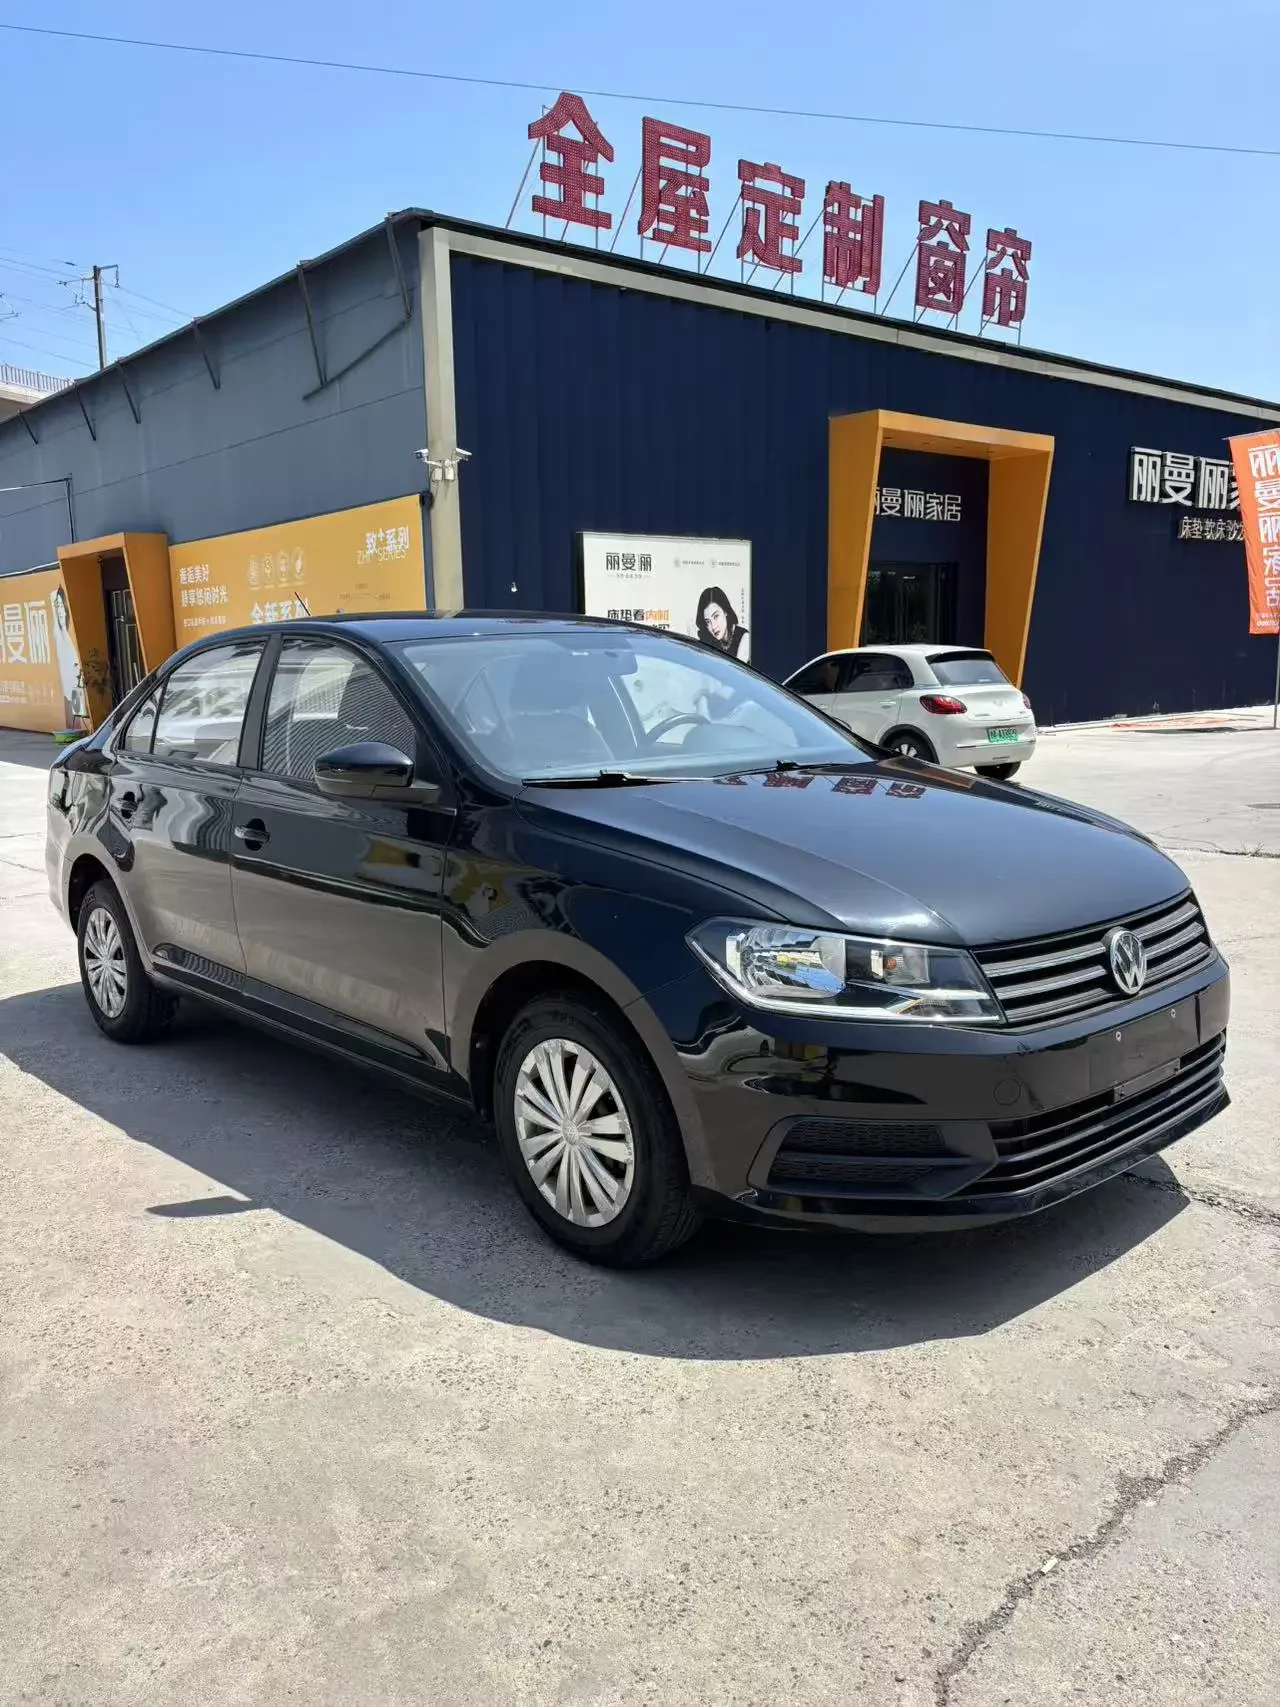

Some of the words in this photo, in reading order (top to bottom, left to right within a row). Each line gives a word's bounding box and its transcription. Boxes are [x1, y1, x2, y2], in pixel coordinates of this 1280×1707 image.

[527, 91, 1032, 327] 全屋定制窗帘
[0, 601, 50, 664] 曼俪
